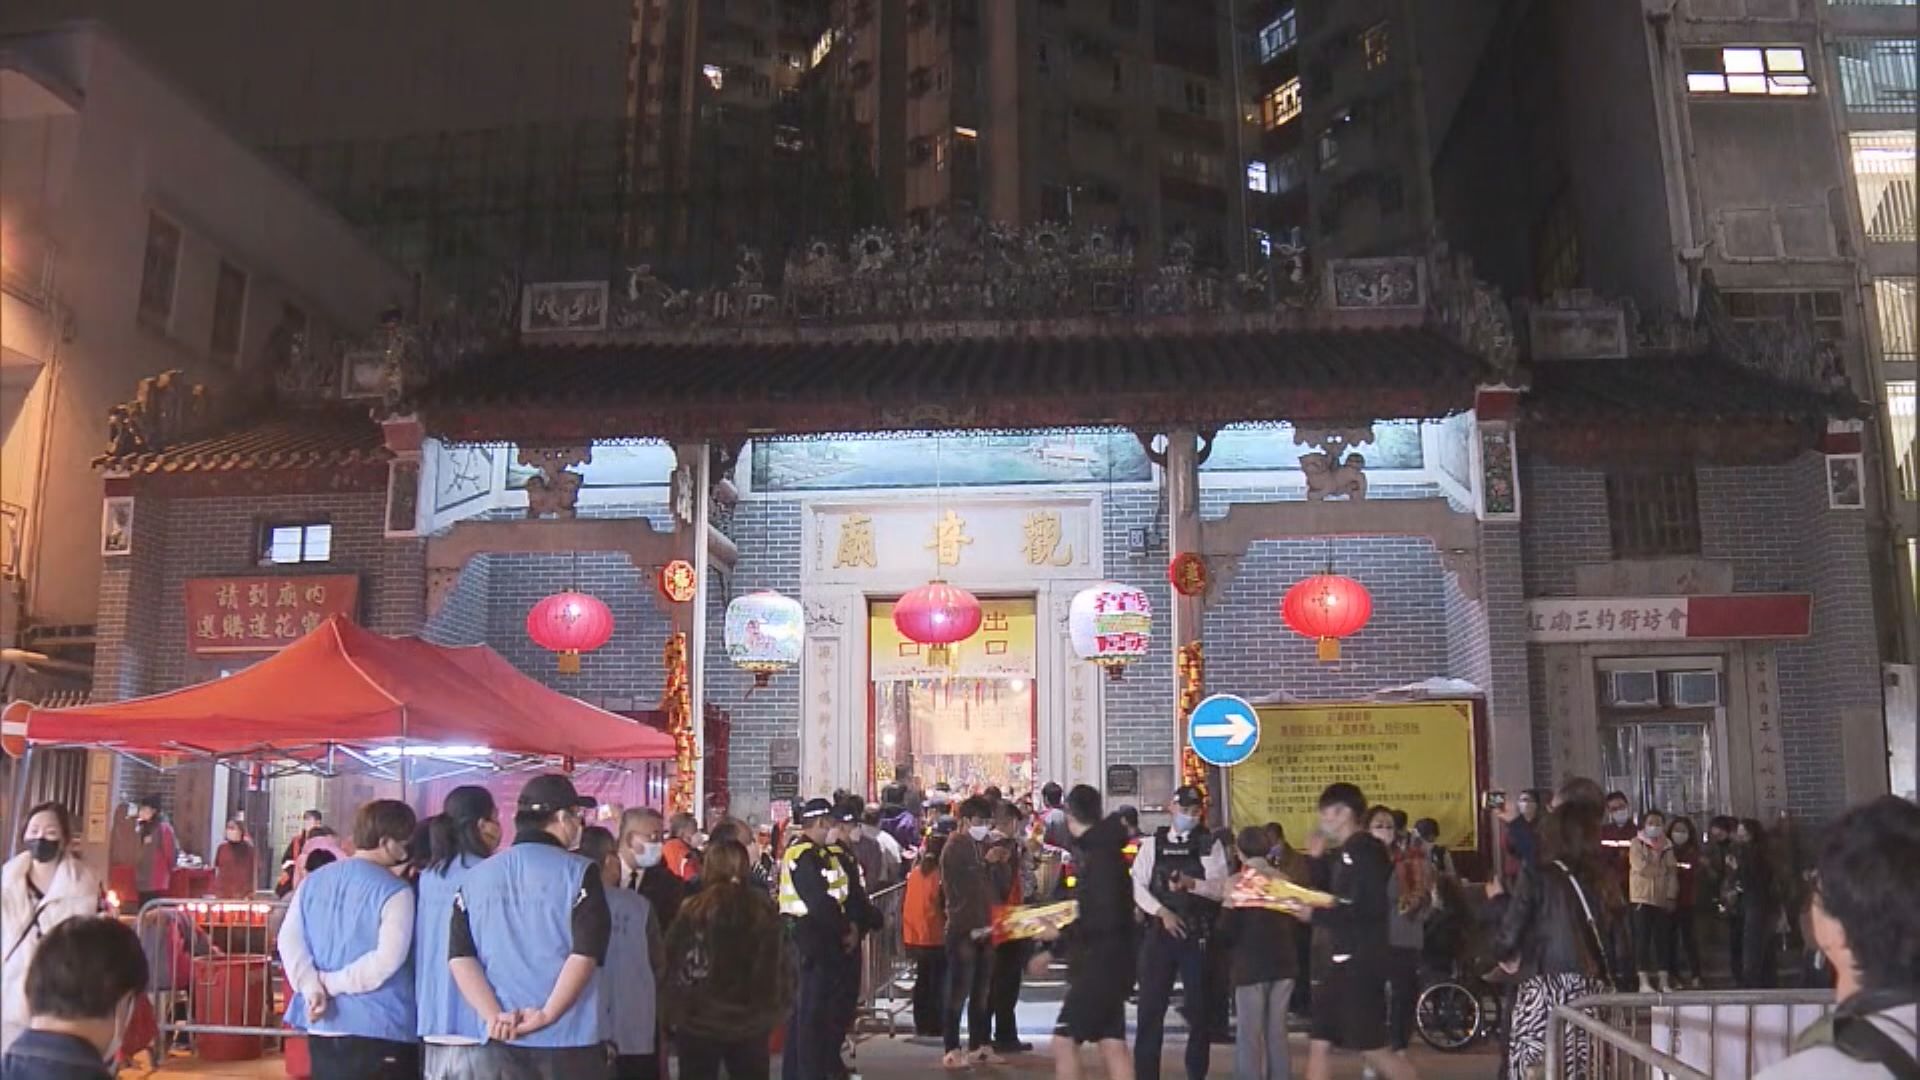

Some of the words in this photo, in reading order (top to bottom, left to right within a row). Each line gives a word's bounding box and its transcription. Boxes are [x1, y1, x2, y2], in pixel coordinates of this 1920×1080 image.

[196, 611, 323, 640] 選購蓮花寶
